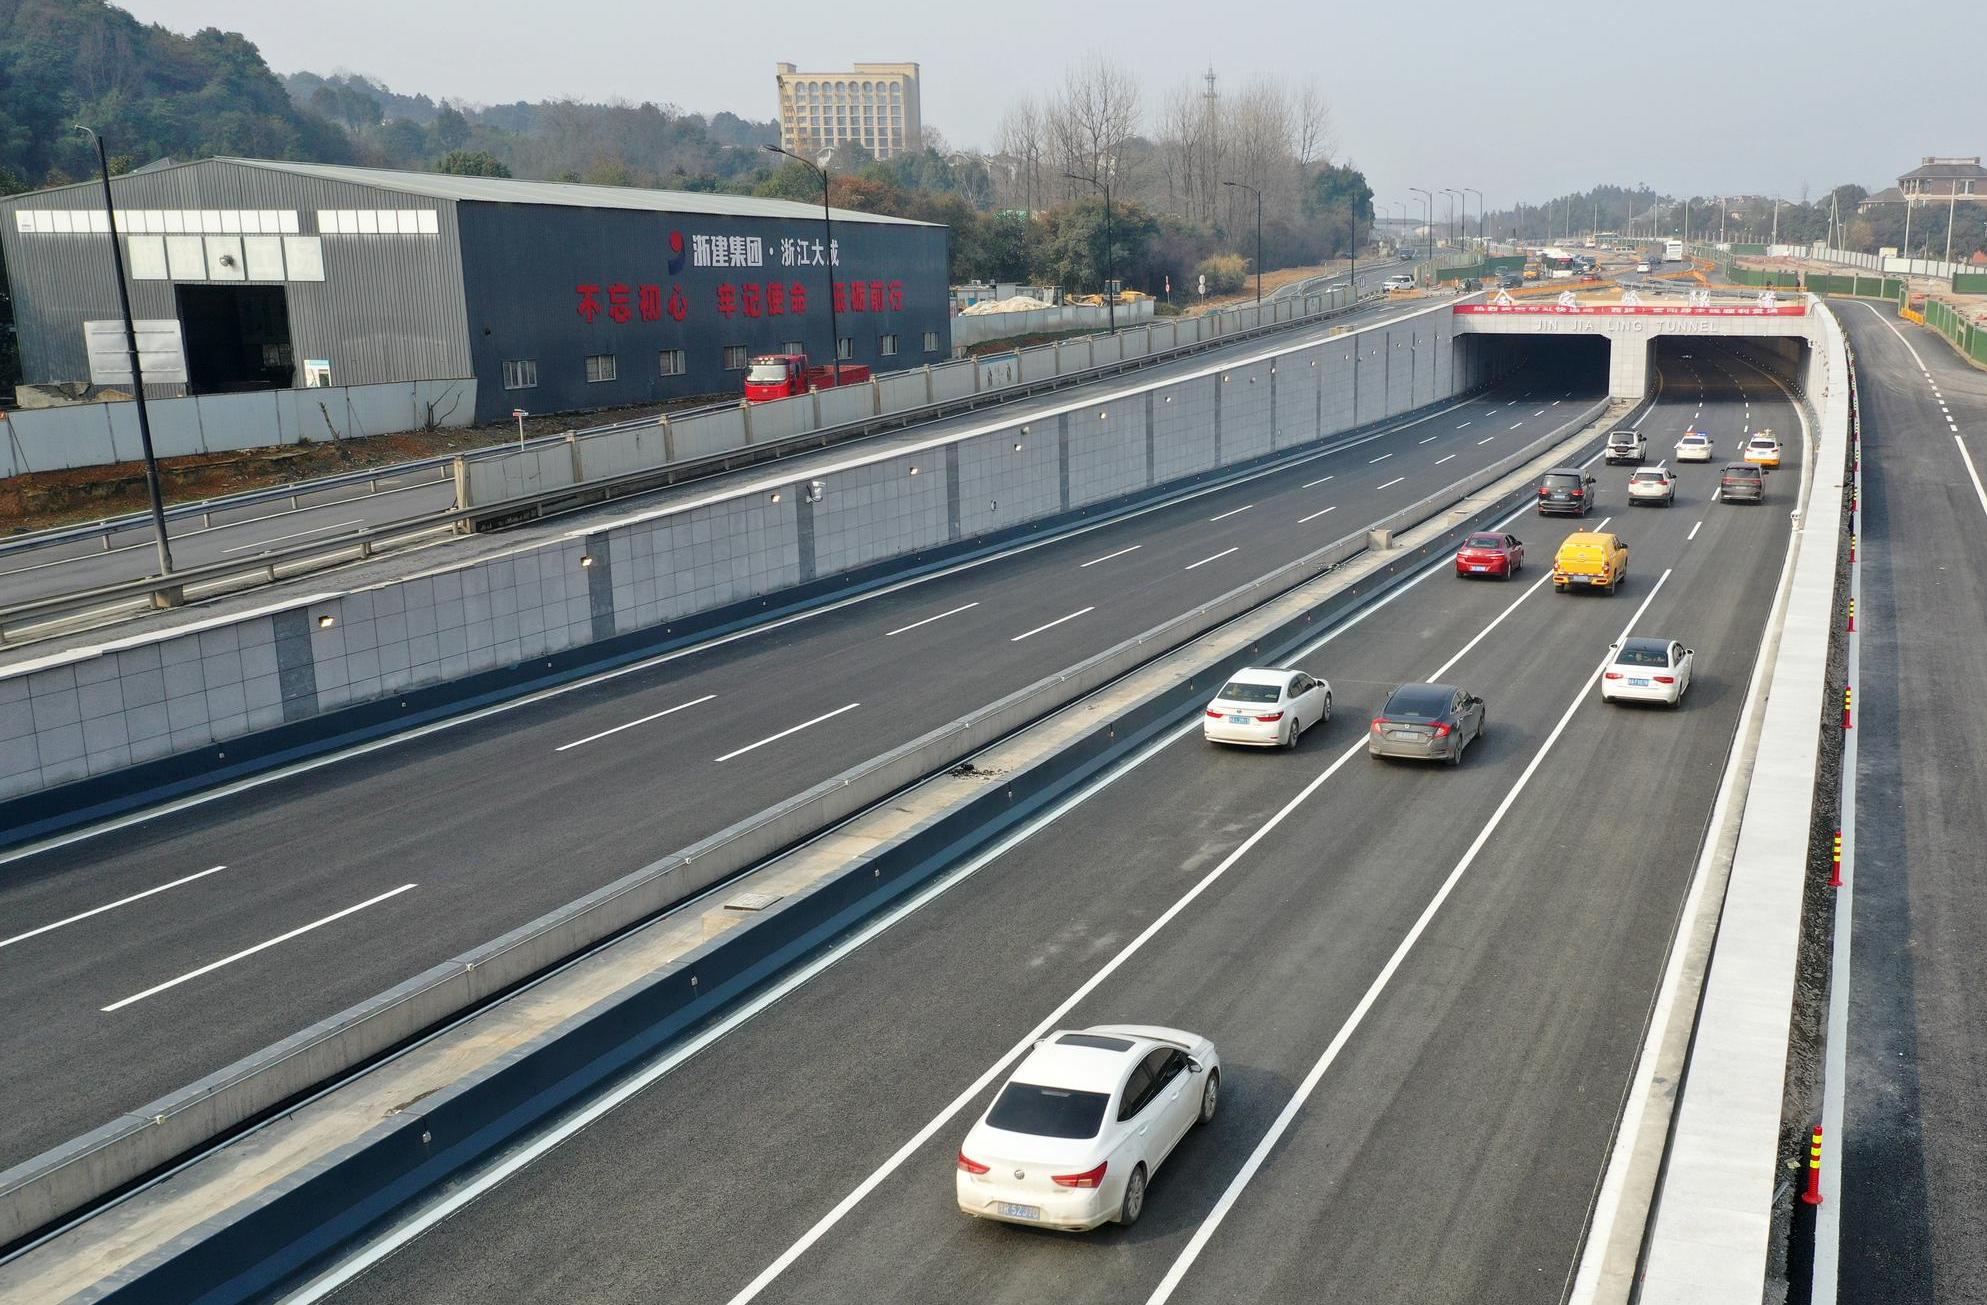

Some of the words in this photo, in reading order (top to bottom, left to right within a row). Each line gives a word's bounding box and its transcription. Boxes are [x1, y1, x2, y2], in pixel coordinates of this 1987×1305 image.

[576, 282, 688, 324] 不忘初心
[717, 282, 807, 319] 牢记使命
[1537, 319, 1559, 331] JIN
[1571, 319, 1594, 331] JIA
[1607, 320, 1643, 332] LING
[1655, 321, 1718, 333] TUNNEL
